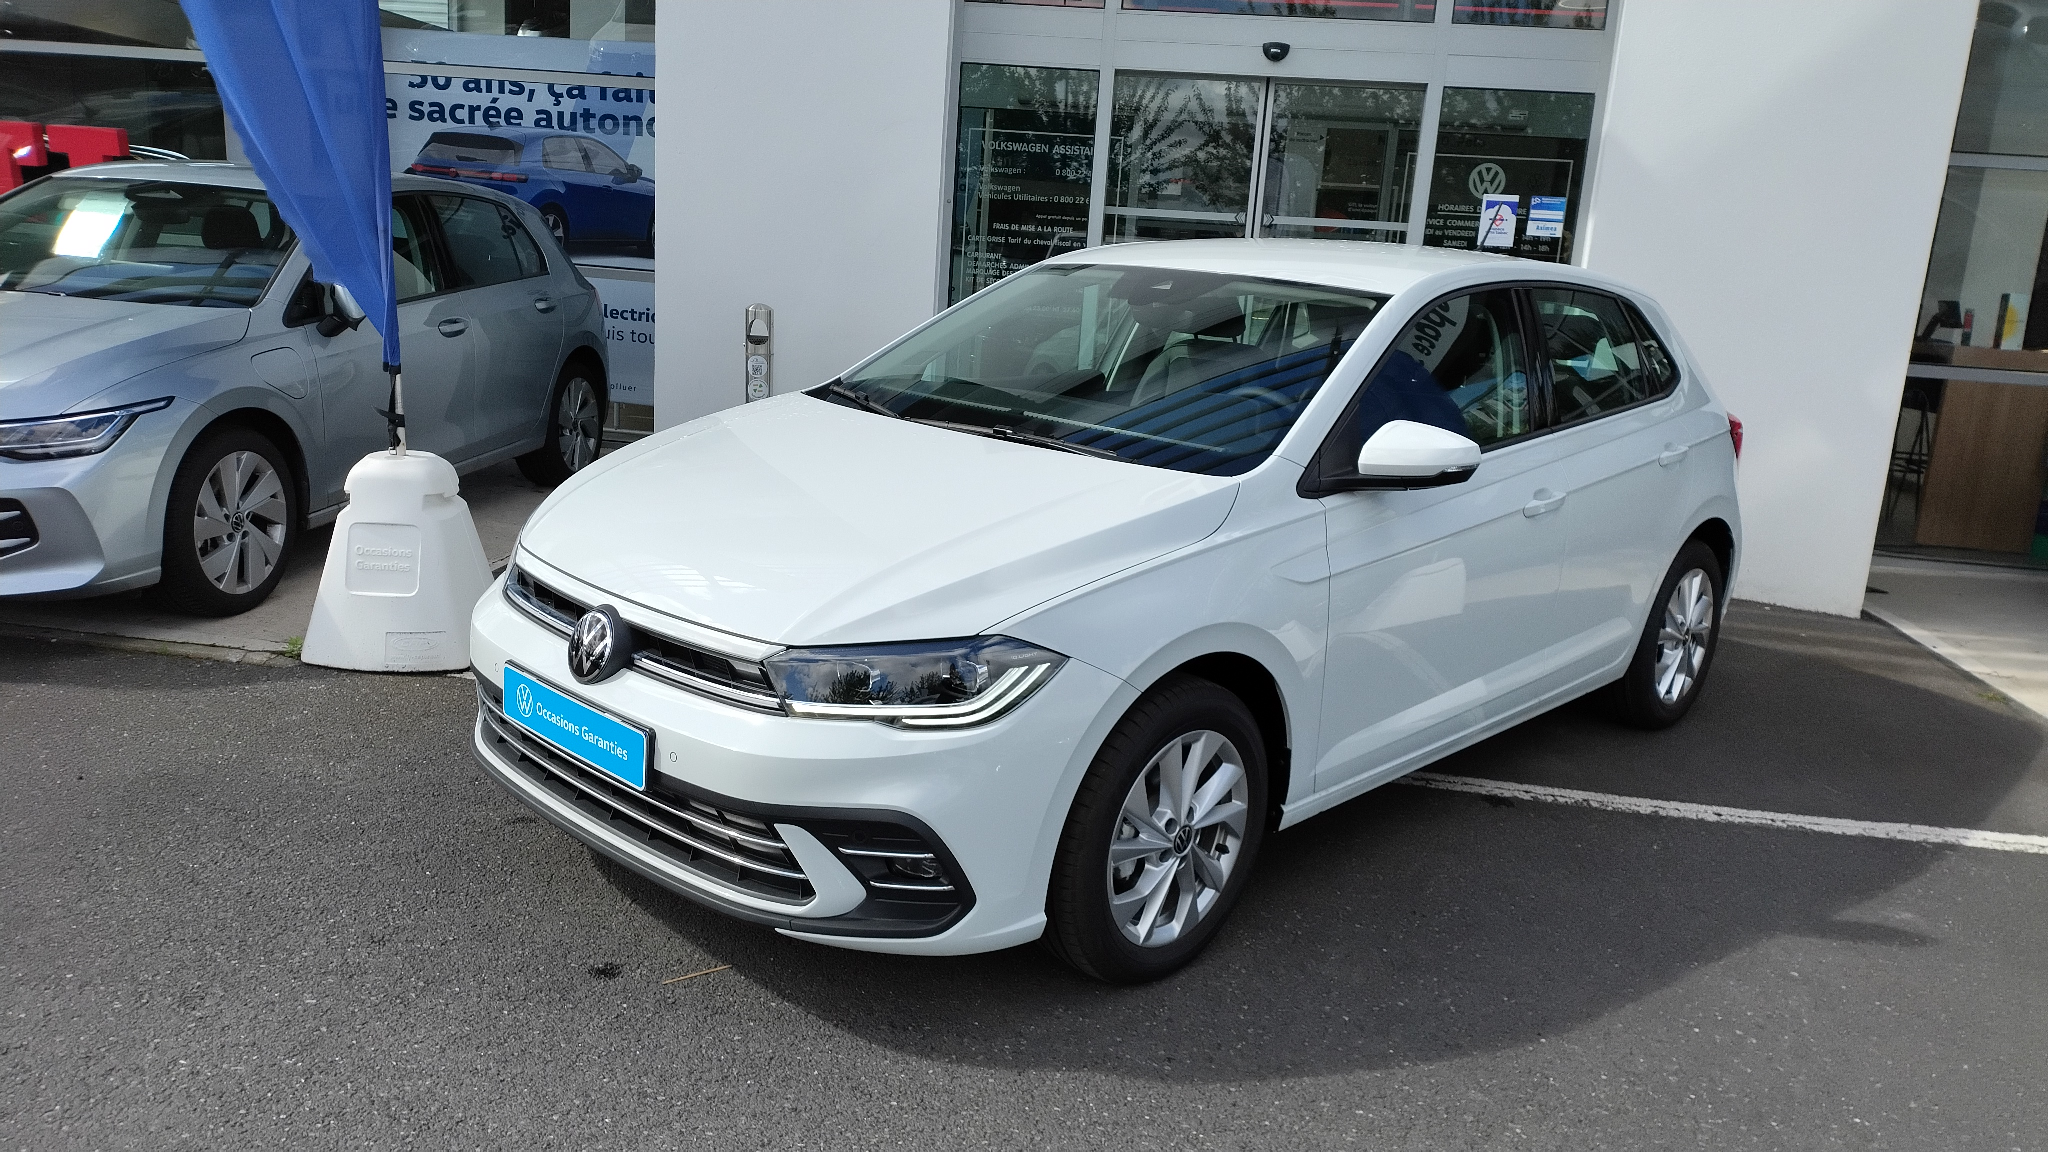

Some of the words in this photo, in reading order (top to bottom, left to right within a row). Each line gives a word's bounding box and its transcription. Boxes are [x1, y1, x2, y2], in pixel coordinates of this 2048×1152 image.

[408, 97, 524, 126] sacrée
[982, 140, 1049, 153] VOLKSWAGEN
[1052, 145, 1093, 156] ASSISTA
[978, 182, 1021, 192] Volkswagen
[1013, 193, 1049, 202] Utilitaires
[1075, 196, 1085, 204] 22
[1437, 203, 1475, 213] HORAIRES
[993, 222, 1010, 230] FRAIS
[1011, 223, 1020, 231] DE
[1020, 224, 1036, 232] MISE
[1053, 226, 1074, 234] ROUTE
[1444, 229, 1476, 237] VENDREDI
[967, 234, 986, 242] CARTE
[986, 235, 1006, 243] GRISE
[1007, 236, 1022, 244] Tarif
[1033, 238, 1053, 246] cheval
[1442, 239, 1468, 248] SAMEDI
[354, 543, 413, 559] Occasions
[354, 559, 411, 574] Garanties
[535, 702, 580, 736] Occasions
[581, 726, 628, 761] Garanties
